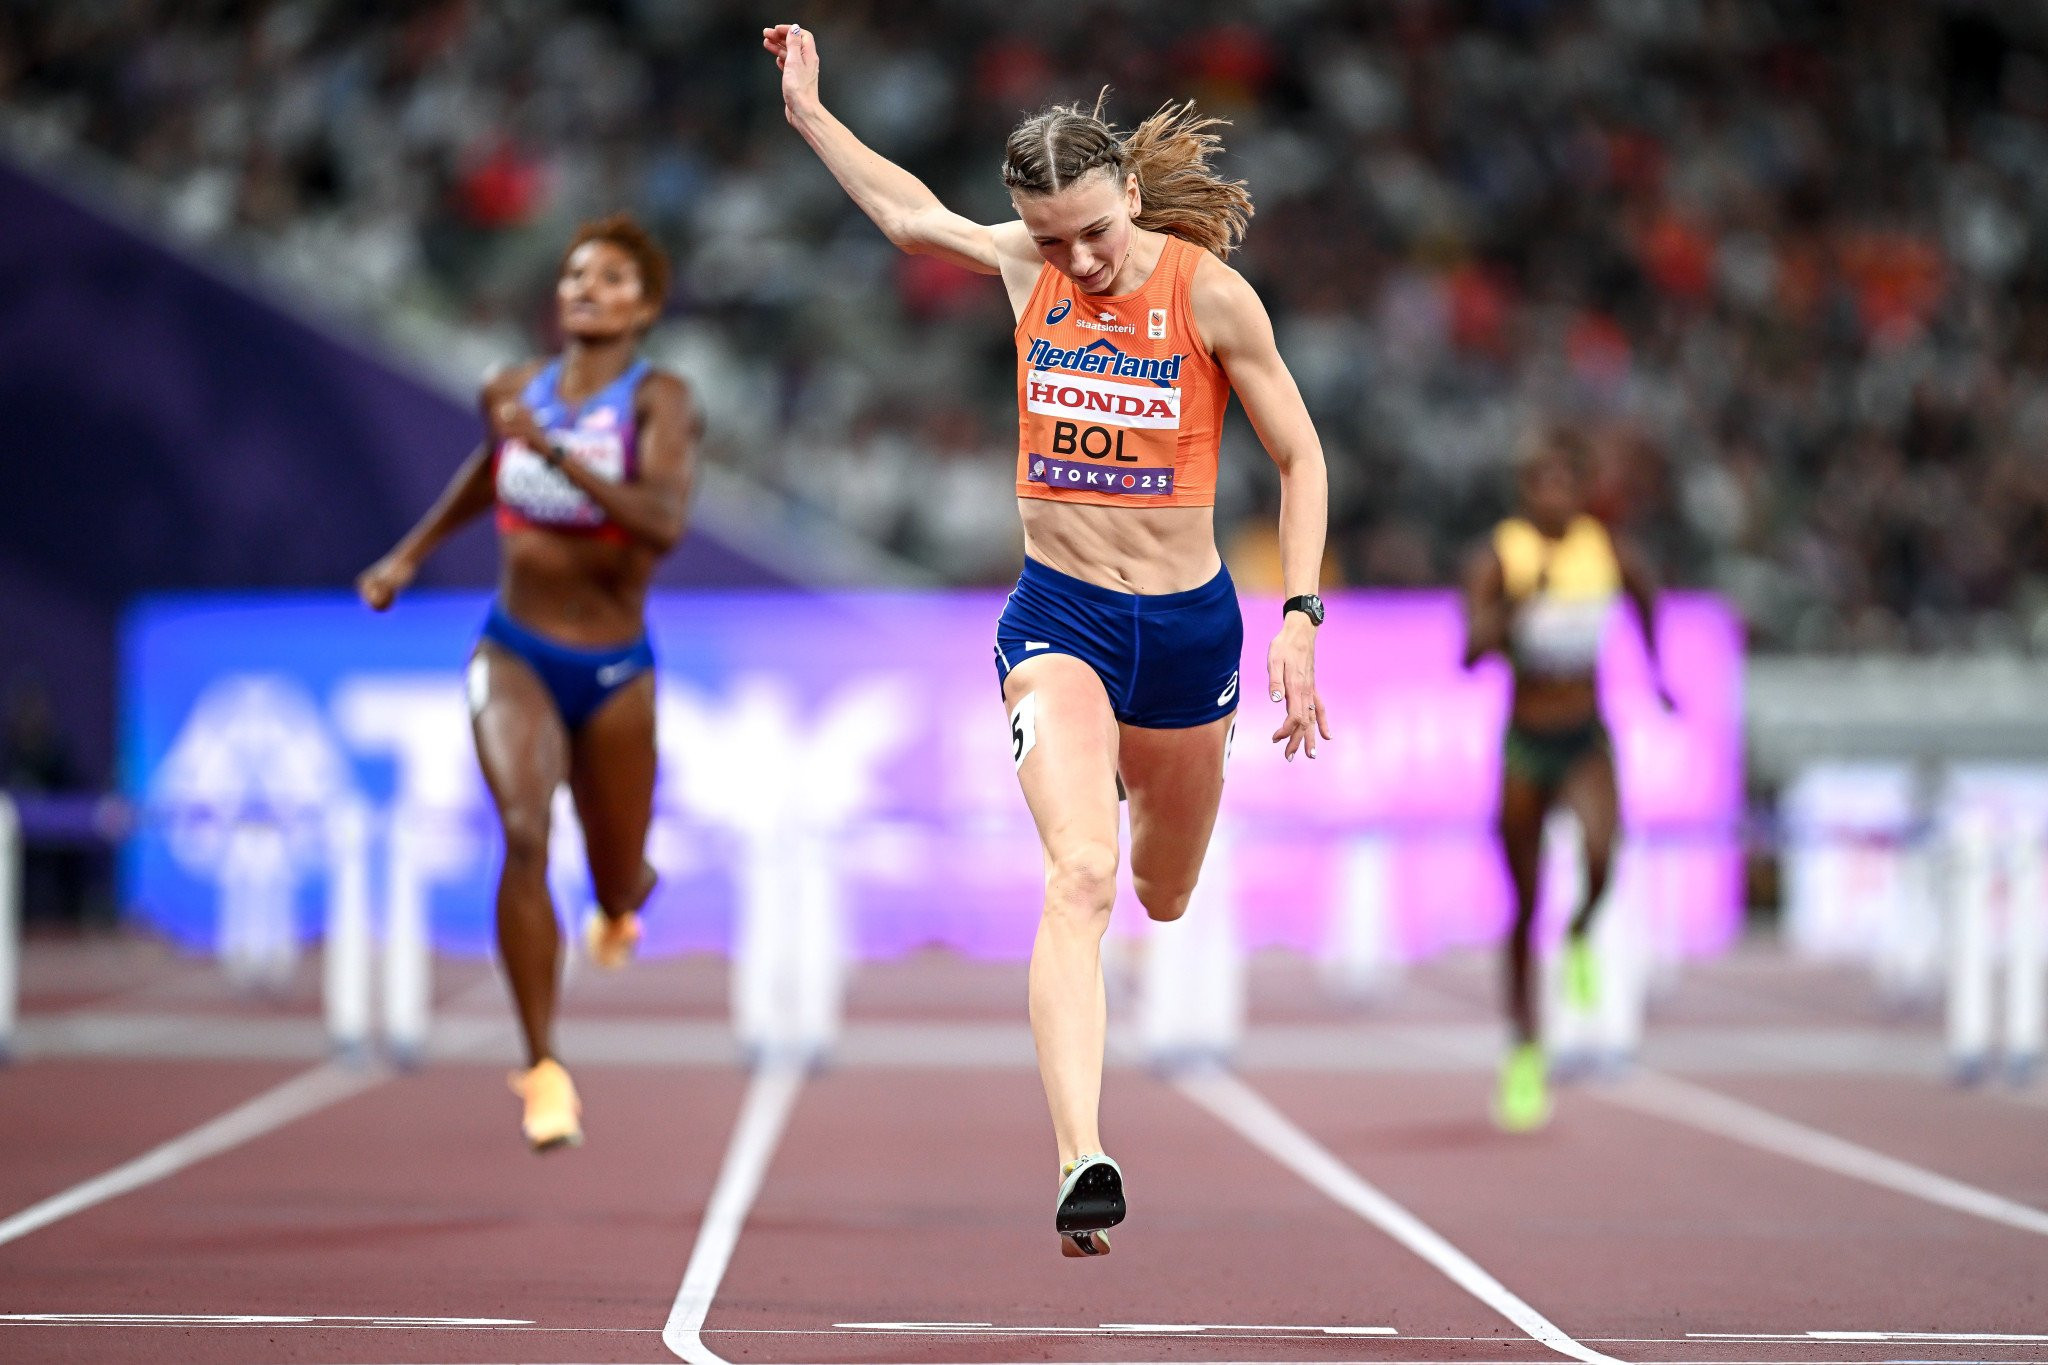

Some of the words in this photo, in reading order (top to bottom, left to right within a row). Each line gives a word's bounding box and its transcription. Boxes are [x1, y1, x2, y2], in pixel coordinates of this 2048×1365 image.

[1076, 319, 1135, 334] Staatsloterij
[1027, 338, 1181, 380] Nederland
[1030, 382, 1176, 418] HONDA
[1053, 421, 1138, 462] BOL
[1011, 712, 1023, 762] 5
